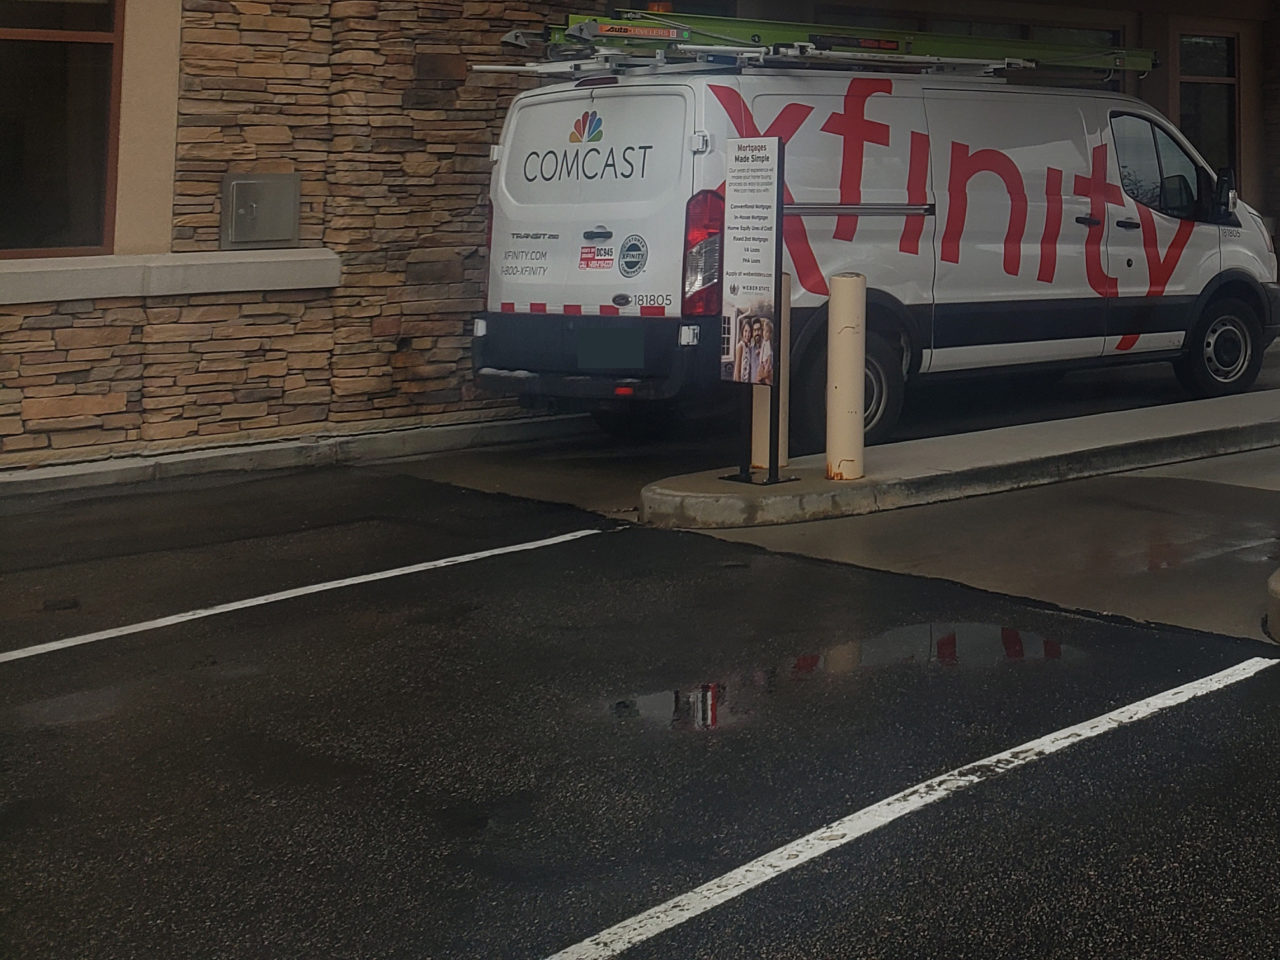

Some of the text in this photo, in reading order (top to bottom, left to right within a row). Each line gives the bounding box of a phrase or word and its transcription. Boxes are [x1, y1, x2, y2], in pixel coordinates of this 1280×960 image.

[738, 144, 767, 153] Mortgages
[523, 145, 653, 182] COMCAST
[735, 154, 769, 164] Made Simple
[504, 250, 547, 261] XFINITY.COM
[596, 248, 613, 257] DC945
[501, 266, 549, 276] 1-800-XFINITY
[633, 294, 672, 306] 181805
